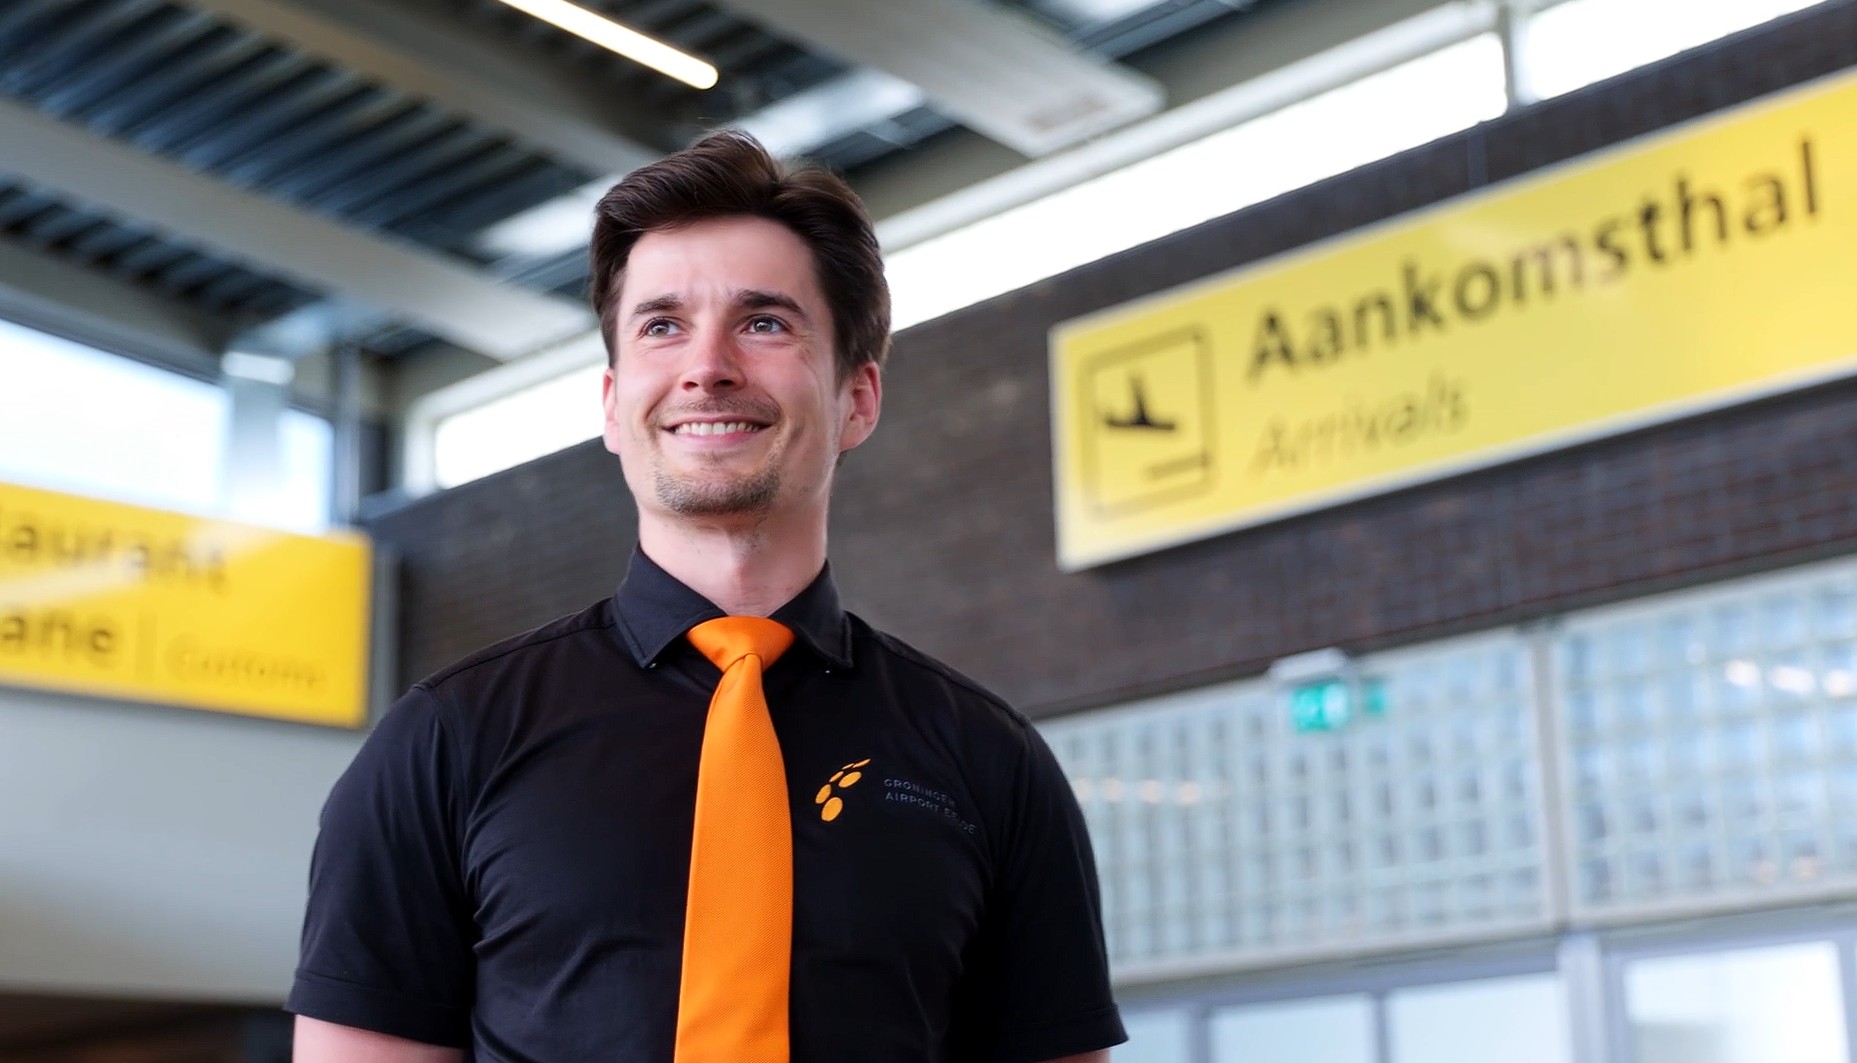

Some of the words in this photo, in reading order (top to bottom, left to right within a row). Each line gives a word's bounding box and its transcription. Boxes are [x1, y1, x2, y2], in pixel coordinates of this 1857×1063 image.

[1245, 132, 1820, 381] Aankomsthal
[1249, 368, 1470, 473] Arrivals
[0, 508, 230, 594] aurant
[885, 791, 939, 813] AIRPORT
